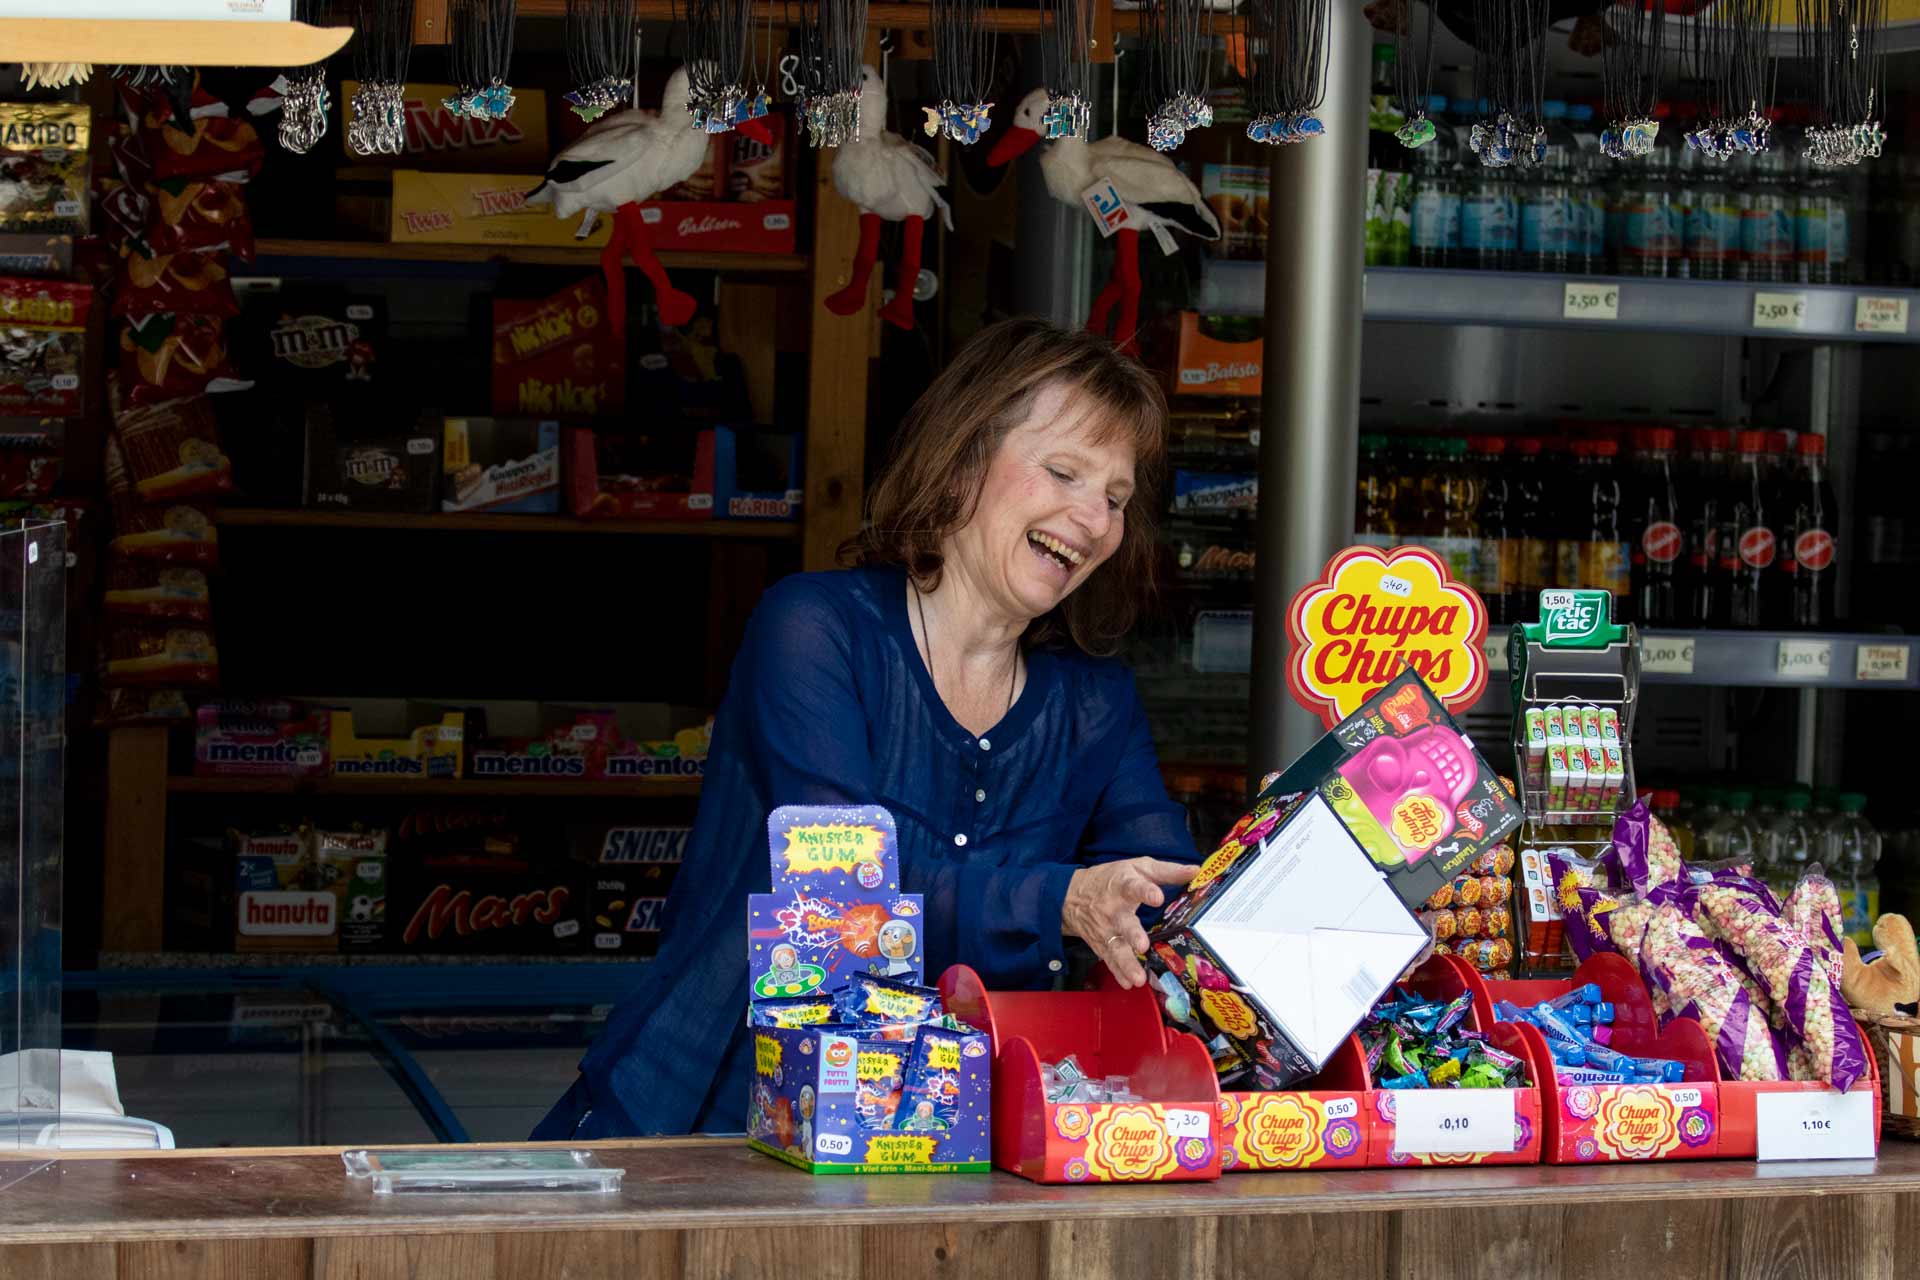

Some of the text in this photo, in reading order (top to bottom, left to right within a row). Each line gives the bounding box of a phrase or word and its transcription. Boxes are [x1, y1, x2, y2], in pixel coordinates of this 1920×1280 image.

[1568, 291, 1617, 308] 2,50 €
[1757, 303, 1788, 318] 2,50
[1206, 361, 1260, 383] Balisto
[729, 496, 789, 517] HARIBO
[1565, 603, 1593, 618] tic
[1322, 594, 1460, 648] Chupa
[1557, 618, 1591, 630] tac
[1314, 639, 1453, 686] Chups
[1643, 647, 1694, 665] 3,00 €
[336, 759, 422, 773] mentos
[476, 756, 583, 774] mentos
[1396, 808, 1430, 845] Chupa
[1407, 797, 1444, 838] Chups
[247, 839, 298, 855] hanuta
[605, 830, 685, 860] SNICK
[798, 830, 864, 846] KNISTER
[807, 846, 856, 863] GUM
[247, 897, 329, 924] hanuta
[400, 882, 570, 945] Mars
[876, 991, 913, 1006] KNISTER
[879, 999, 908, 1014] GUM
[1206, 993, 1241, 1032] Chupa
[1217, 991, 1253, 1031] Chups
[937, 1045, 960, 1055] KNIST
[824, 1079, 849, 1087] FRUTTI
[826, 1070, 848, 1078] TUTTI
[1573, 1071, 1621, 1083] mentos
[1618, 1105, 1661, 1123] Chupa
[1261, 1114, 1305, 1133] Chupa
[1617, 1121, 1659, 1144] Chups
[876, 1138, 923, 1151] KNISTER
[1111, 1126, 1157, 1146] Chupa
[1258, 1130, 1302, 1153] Chups
[880, 1150, 916, 1162] GUM
[1109, 1142, 1155, 1166] Chups
[863, 1165, 880, 1174] Viel
[881, 1165, 898, 1173] drin
